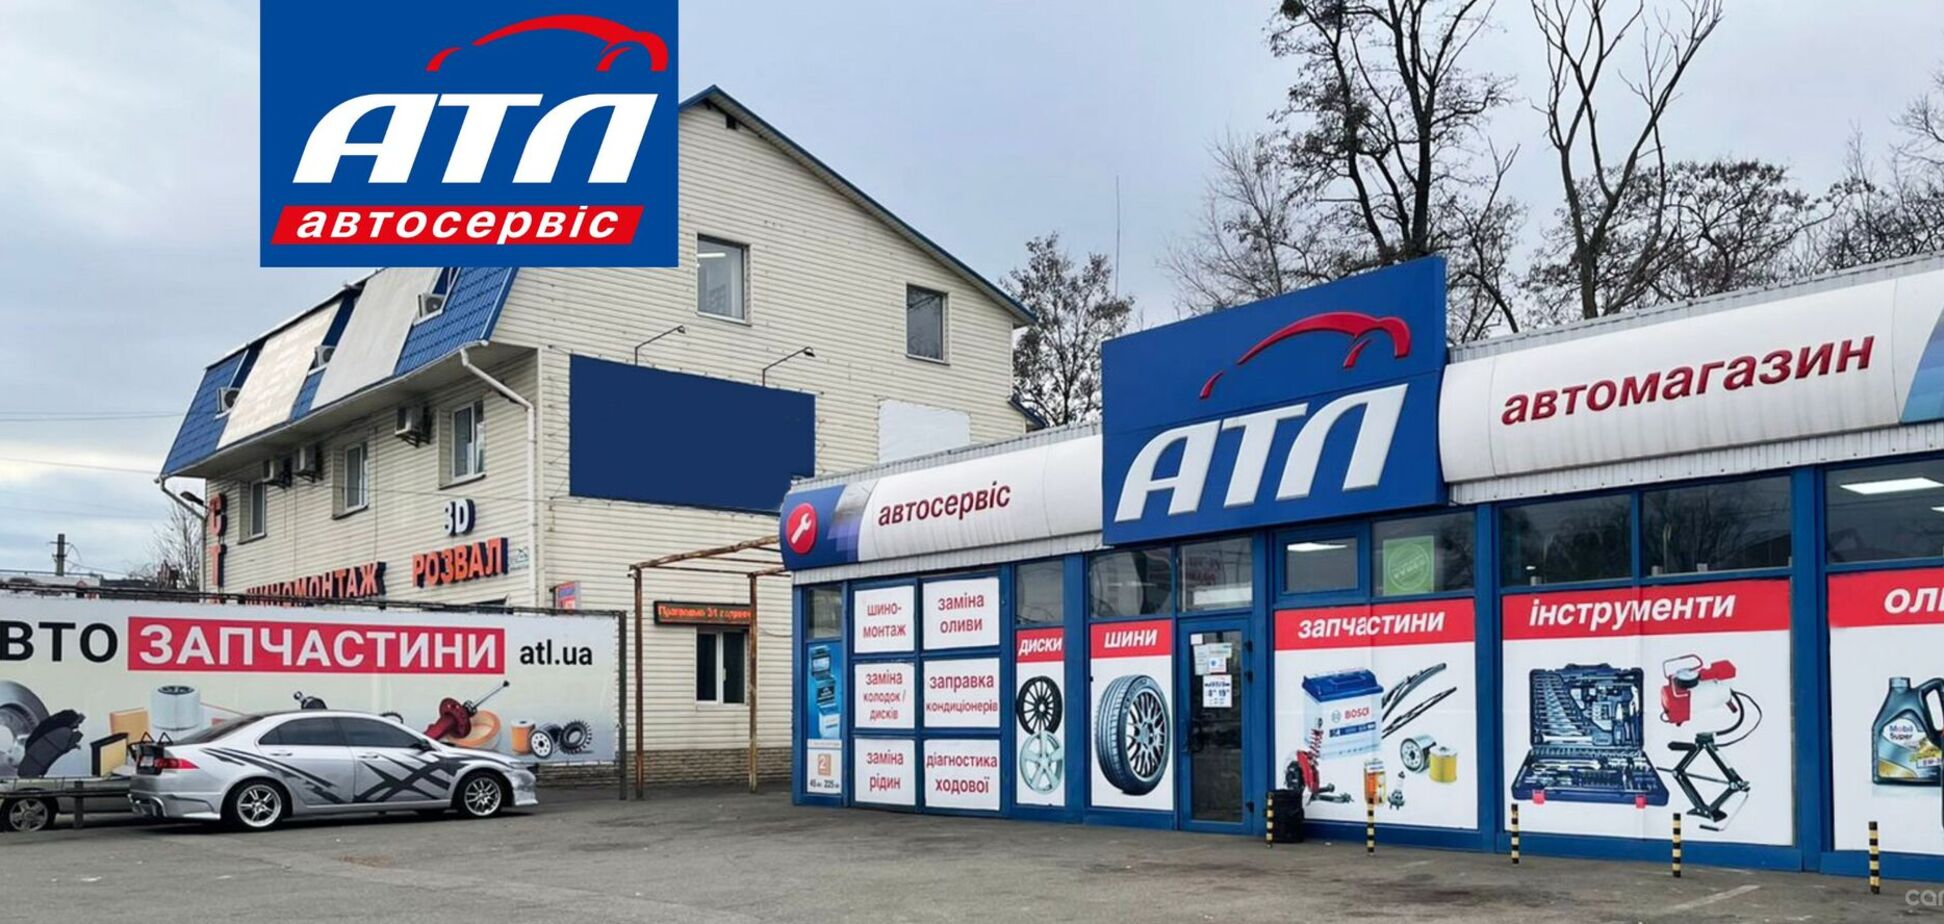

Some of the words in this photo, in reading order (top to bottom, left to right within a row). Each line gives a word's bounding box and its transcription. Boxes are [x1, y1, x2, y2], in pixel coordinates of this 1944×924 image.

[1501, 335, 1875, 426] автомагазин
[1114, 383, 1410, 523] АТЛ
[878, 480, 1011, 526] автосервіс
[443, 498, 472, 537] 3D
[208, 492, 225, 604] СТ
[412, 537, 505, 588] РОЗВАЛ
[867, 602, 902, 616] шино-
[938, 592, 984, 611] заміна
[1884, 587, 1944, 614] ол
[1529, 595, 1736, 631] інструменти
[863, 624, 906, 638] монтаж
[940, 618, 983, 633] оливи
[1298, 612, 1445, 638] запчастини
[0, 620, 118, 663] ВТО
[139, 624, 496, 669] ЗАПЧАСТИНИ
[519, 639, 593, 665] atl.ua
[866, 669, 903, 685] заміна
[930, 674, 994, 693] заправка
[863, 692, 900, 704] колодок
[926, 699, 998, 715] кондиціонерів
[869, 706, 899, 720] дисків
[866, 749, 903, 765] заміна
[926, 752, 998, 768] діагностика
[869, 773, 900, 792] рідин
[935, 776, 990, 794] ходової
